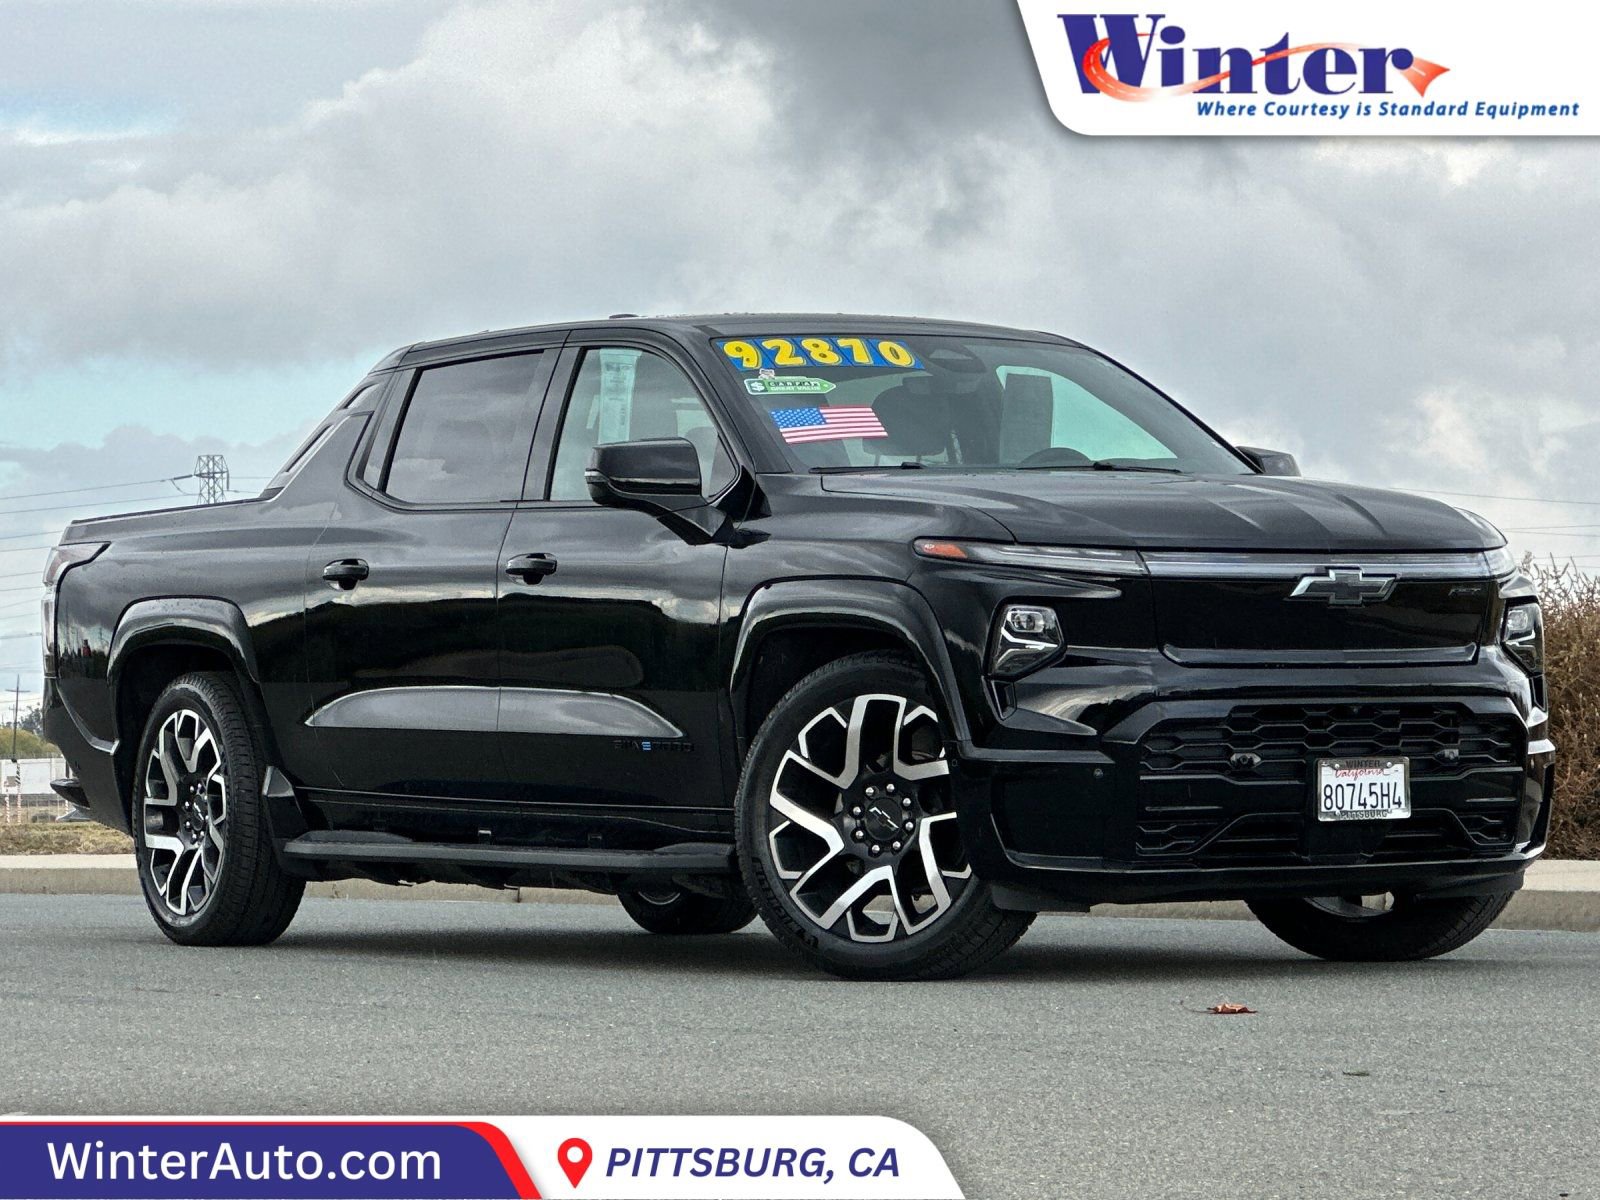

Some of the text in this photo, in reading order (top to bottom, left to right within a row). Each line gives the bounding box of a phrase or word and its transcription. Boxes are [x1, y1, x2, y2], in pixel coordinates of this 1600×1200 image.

[723, 338, 914, 368] 92870
[1345, 760, 1381, 768] WINTER
[1323, 781, 1402, 810] 80745H4
[1340, 810, 1388, 819] PITTSBURG
